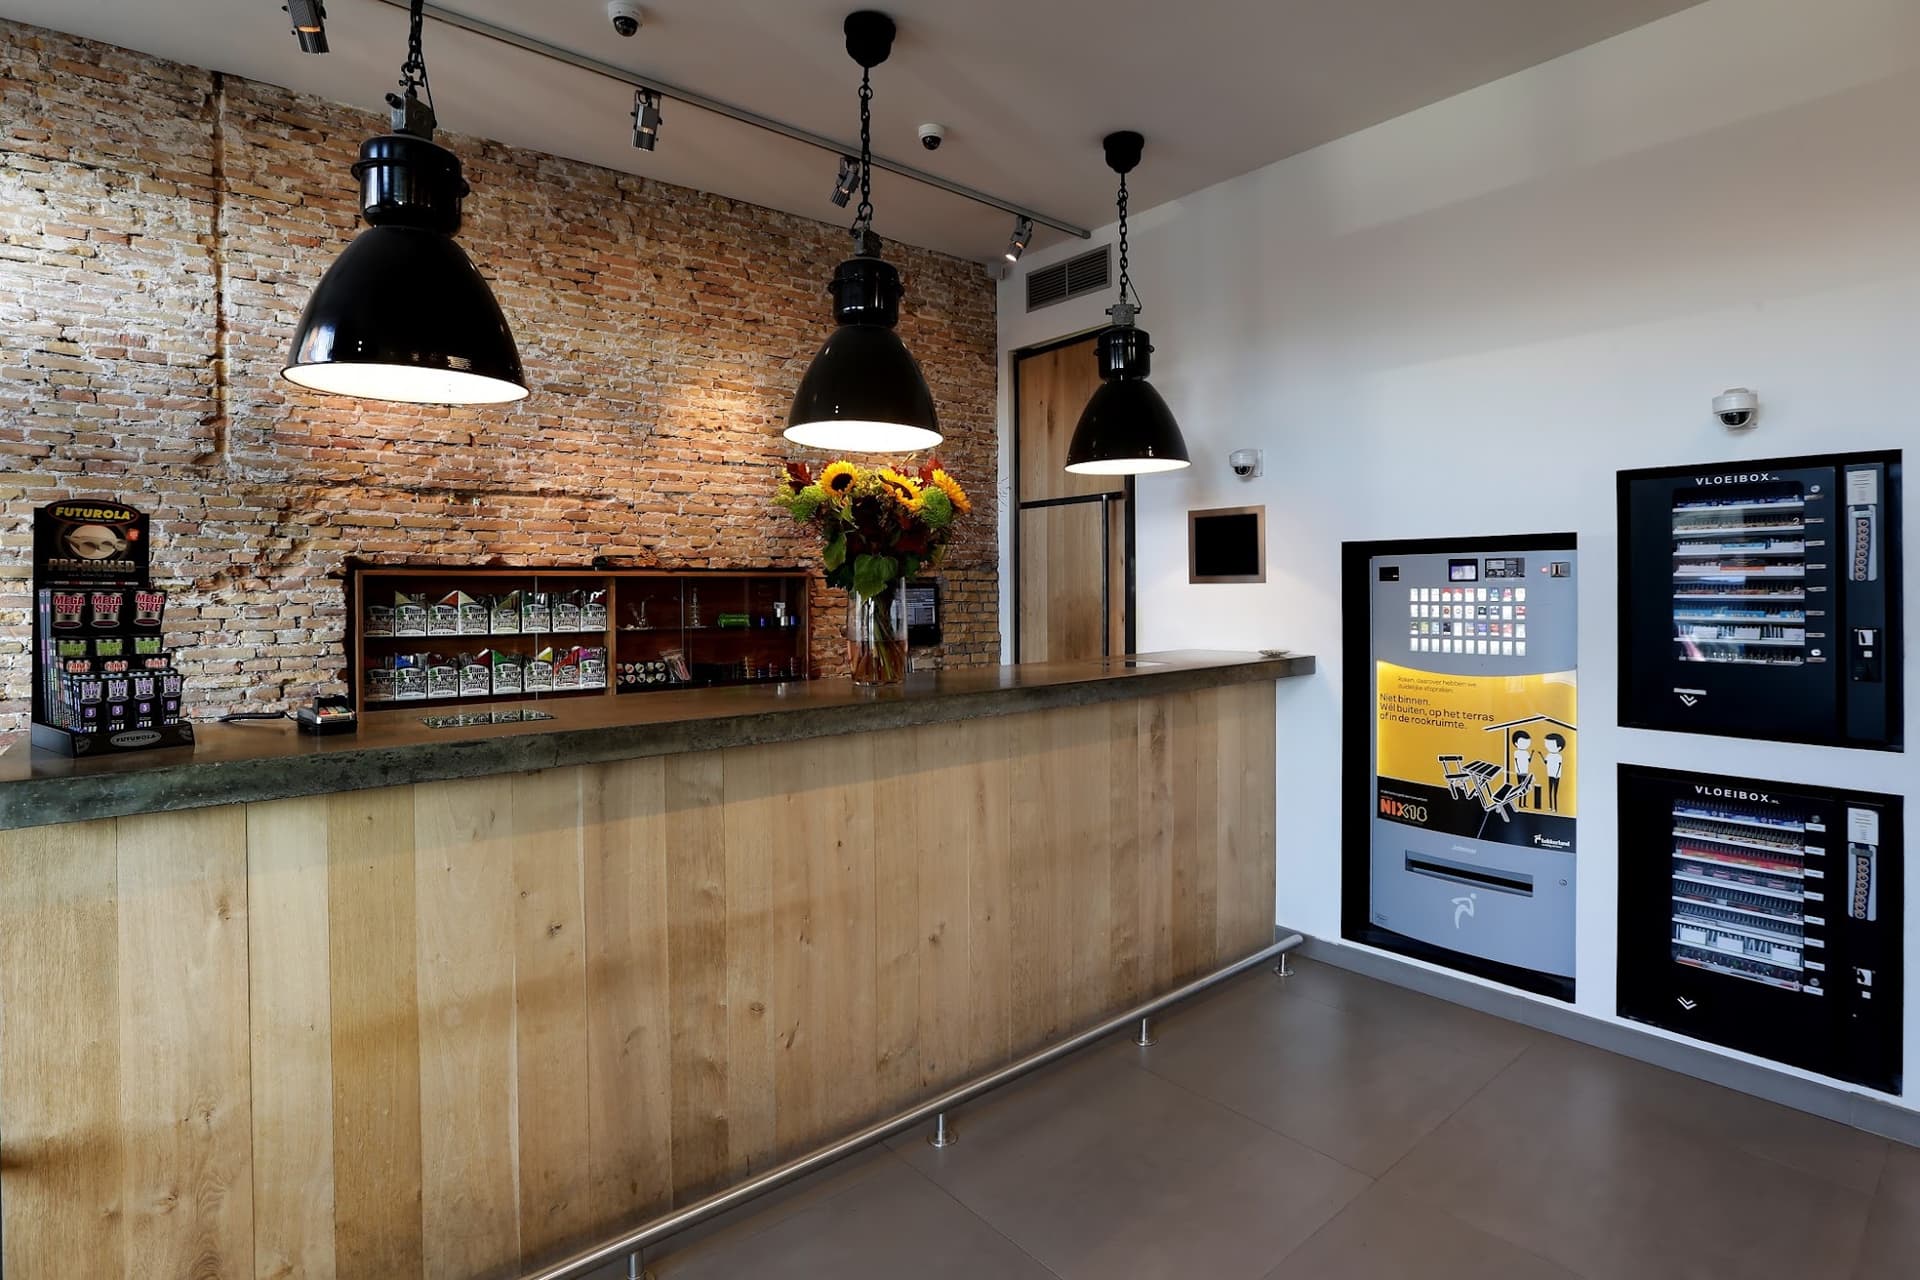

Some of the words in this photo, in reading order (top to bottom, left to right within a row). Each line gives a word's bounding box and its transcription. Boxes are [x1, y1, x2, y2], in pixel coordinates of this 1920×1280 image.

[55, 507, 131, 520] FUTUROLA
[48, 558, 136, 573] PRE-ROLLED
[53, 594, 85, 605] MEGA
[92, 594, 122, 605] MEGA
[135, 593, 165, 604] MEGA
[56, 604, 81, 614] SIZE
[95, 604, 119, 614] SIZE
[137, 602, 161, 612] SIZE
[1380, 693, 1396, 702] Niet
[1398, 694, 1431, 706] binnen.
[1380, 712, 1389, 720] of
[1389, 712, 1398, 721] in
[1398, 714, 1410, 723] de
[1397, 703, 1428, 716] buiten,
[1429, 709, 1442, 718] op
[1444, 709, 1460, 719] het
[1462, 711, 1495, 722] terras
